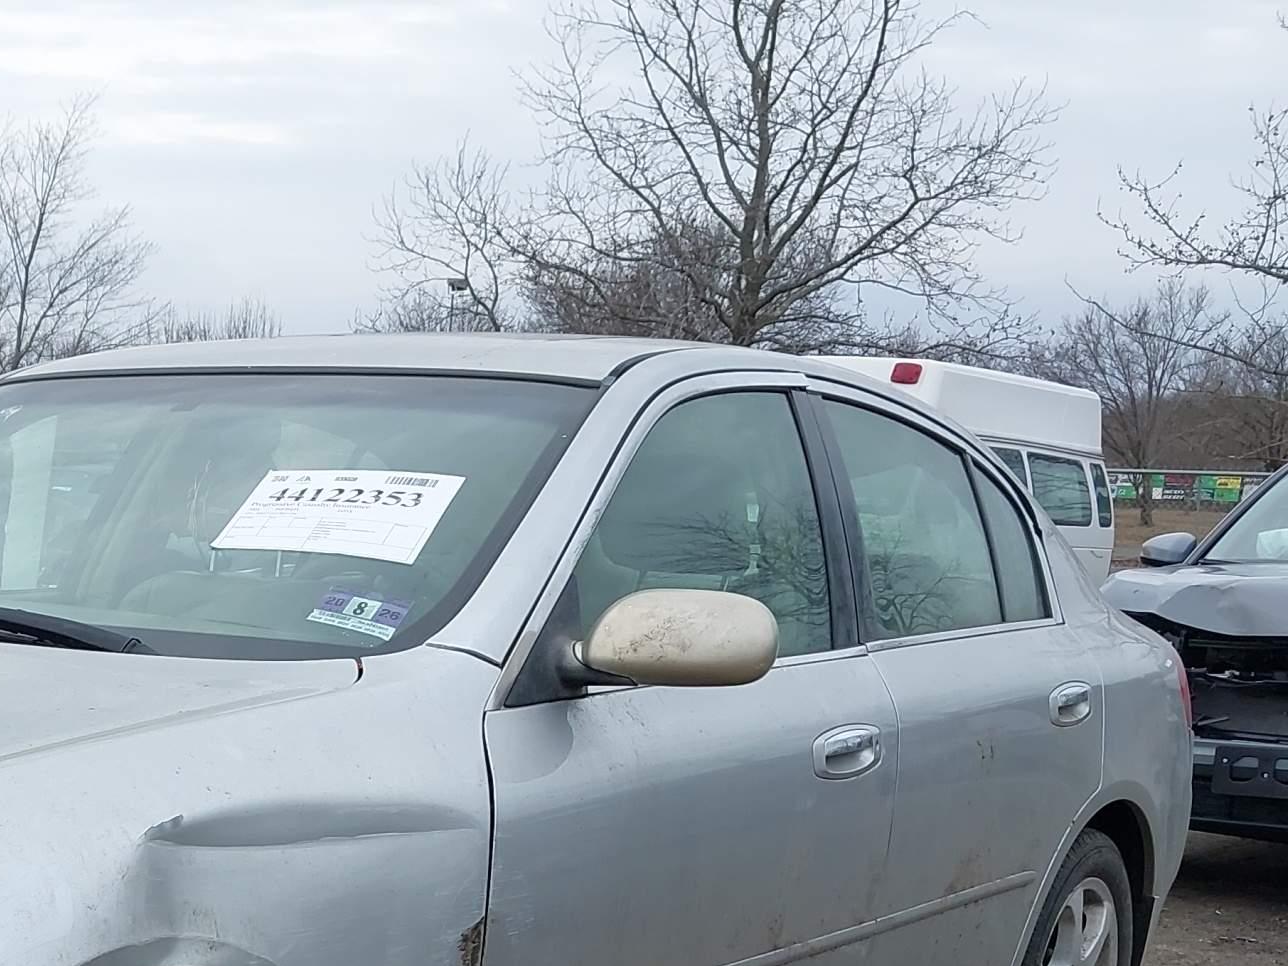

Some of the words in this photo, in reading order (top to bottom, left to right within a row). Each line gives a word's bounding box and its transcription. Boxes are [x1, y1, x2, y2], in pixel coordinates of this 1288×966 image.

[268, 487, 424, 508] 44122353
[324, 596, 346, 607] 20
[352, 601, 368, 616] 8
[378, 608, 401, 621] 26
